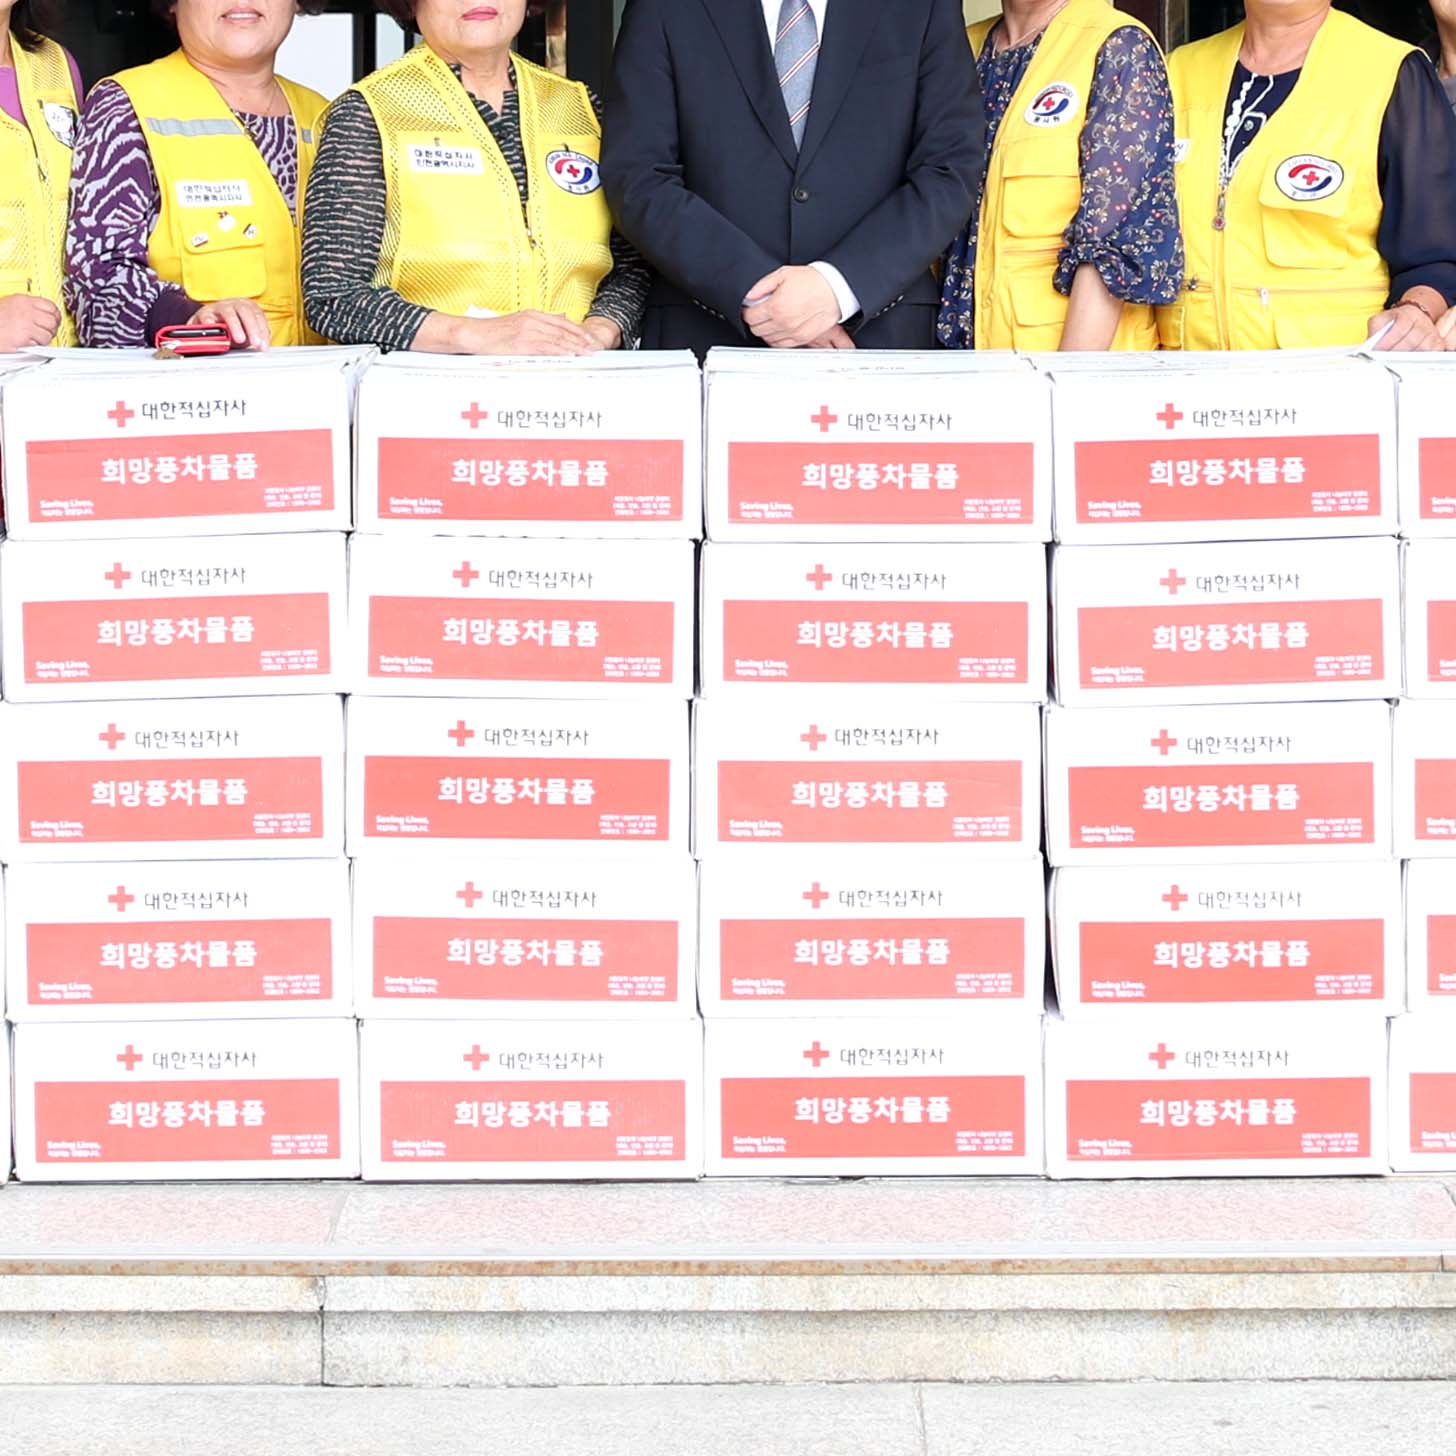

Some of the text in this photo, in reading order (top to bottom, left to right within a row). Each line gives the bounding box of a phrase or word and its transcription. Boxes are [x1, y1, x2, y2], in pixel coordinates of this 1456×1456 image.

[141, 399, 247, 421] 대한적십자사
[497, 409, 603, 429] 대한적십자사
[847, 412, 953, 432] 대한적십자사
[1192, 408, 1297, 428] 대한적십자사
[101, 453, 258, 485] 희망풍차물품
[451, 458, 609, 487] 희망풍차물품
[802, 463, 959, 490] 희망풍차물품
[1149, 456, 1306, 487] 희망풍차물품
[141, 567, 246, 588] 대한적십자사
[488, 569, 593, 589] 대한적십자사
[841, 571, 947, 591] 대한적십자사
[1196, 573, 1300, 593] 대한적십자사
[97, 615, 255, 647] 희망풍차물품
[442, 617, 600, 647] 희망풍차물품
[797, 620, 954, 649] 희망풍차물품
[1152, 621, 1310, 652] 희망풍차물품
[134, 729, 239, 749] 대한적십자사
[484, 727, 589, 747] 대한적십자사
[834, 727, 939, 746] 대한적십자사
[1187, 735, 1291, 755] 대한적십자사
[91, 778, 248, 808] 희망풍차물품
[437, 776, 596, 805] 희망풍차물품
[791, 781, 948, 809] 희망풍차물품
[1142, 783, 1300, 813] 희망풍차물품
[144, 891, 248, 911] 대한적십자사
[492, 889, 597, 909] 대한적십자사
[838, 889, 943, 908] 대한적십자사
[1198, 890, 1302, 909] 대한적십자사
[100, 940, 258, 970] 희망풍차물품
[446, 937, 604, 967] 희망풍차물품
[794, 938, 951, 966] 희망풍차물품
[1153, 940, 1311, 969] 희망풍차물품
[152, 1051, 257, 1070] 대한적십자사
[499, 1051, 603, 1070] 대한적십자사
[840, 1047, 944, 1066] 대한적십자사
[1185, 1049, 1289, 1068] 대한적십자사
[108, 1099, 266, 1128] 희망풍차물품
[454, 1100, 611, 1128] 희망풍차물품
[794, 1096, 951, 1124] 희망풍차물품
[1140, 1098, 1297, 1127] 희망풍차물품
